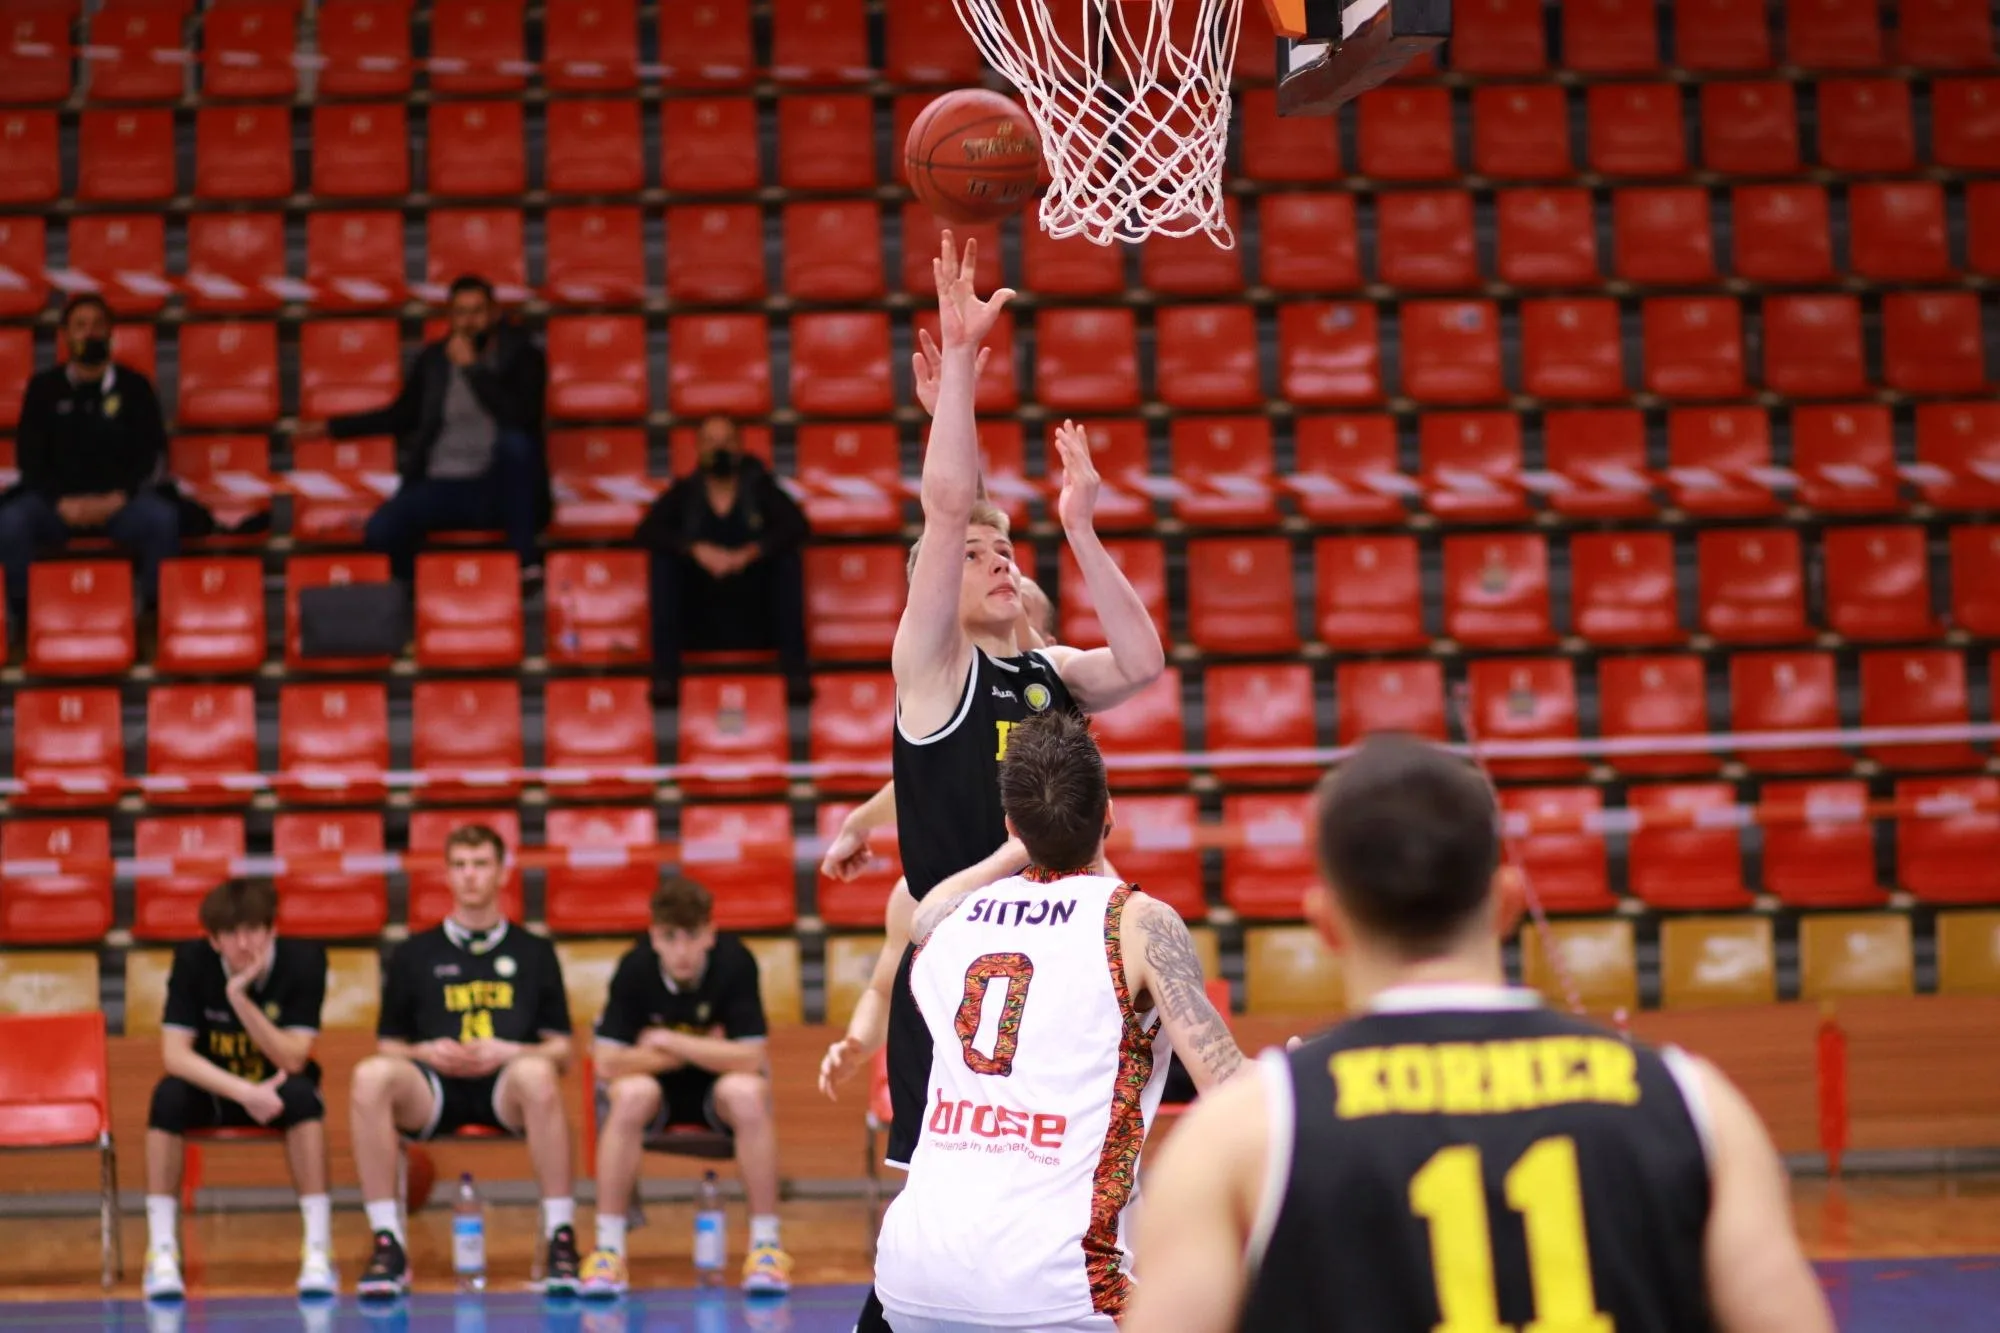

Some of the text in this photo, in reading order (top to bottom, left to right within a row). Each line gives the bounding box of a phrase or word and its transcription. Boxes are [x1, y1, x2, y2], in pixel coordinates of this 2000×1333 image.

[954, 952, 1034, 1077] 0
[929, 1087, 1067, 1148] brose
[1408, 1134, 1616, 1333] 11
